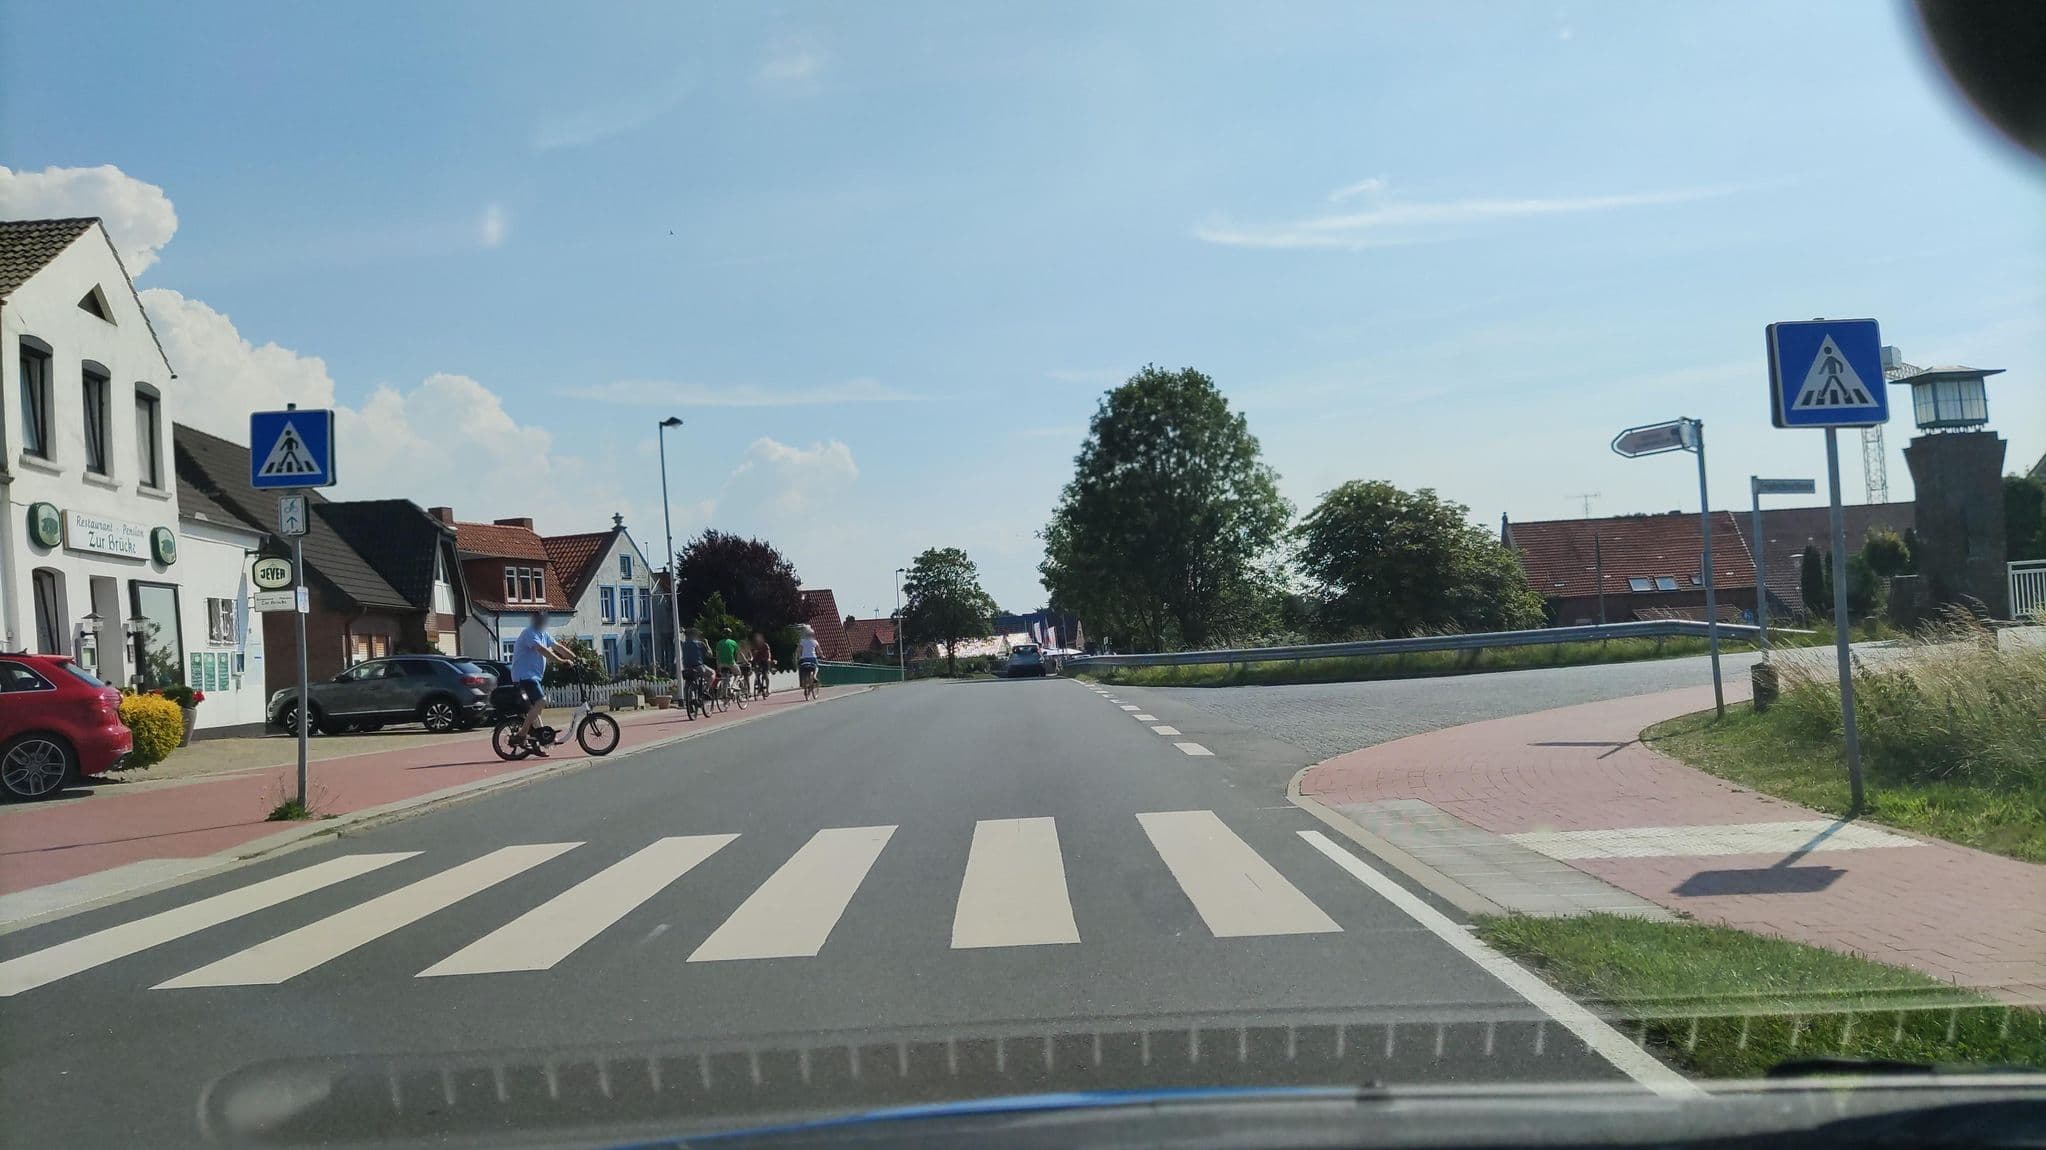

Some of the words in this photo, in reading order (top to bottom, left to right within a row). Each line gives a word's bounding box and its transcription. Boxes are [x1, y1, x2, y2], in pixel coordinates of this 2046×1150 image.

[76, 515, 113, 532] Restaurant
[88, 531, 105, 550] Zur
[108, 534, 137, 554] Brücke
[260, 567, 286, 581] JEVER
